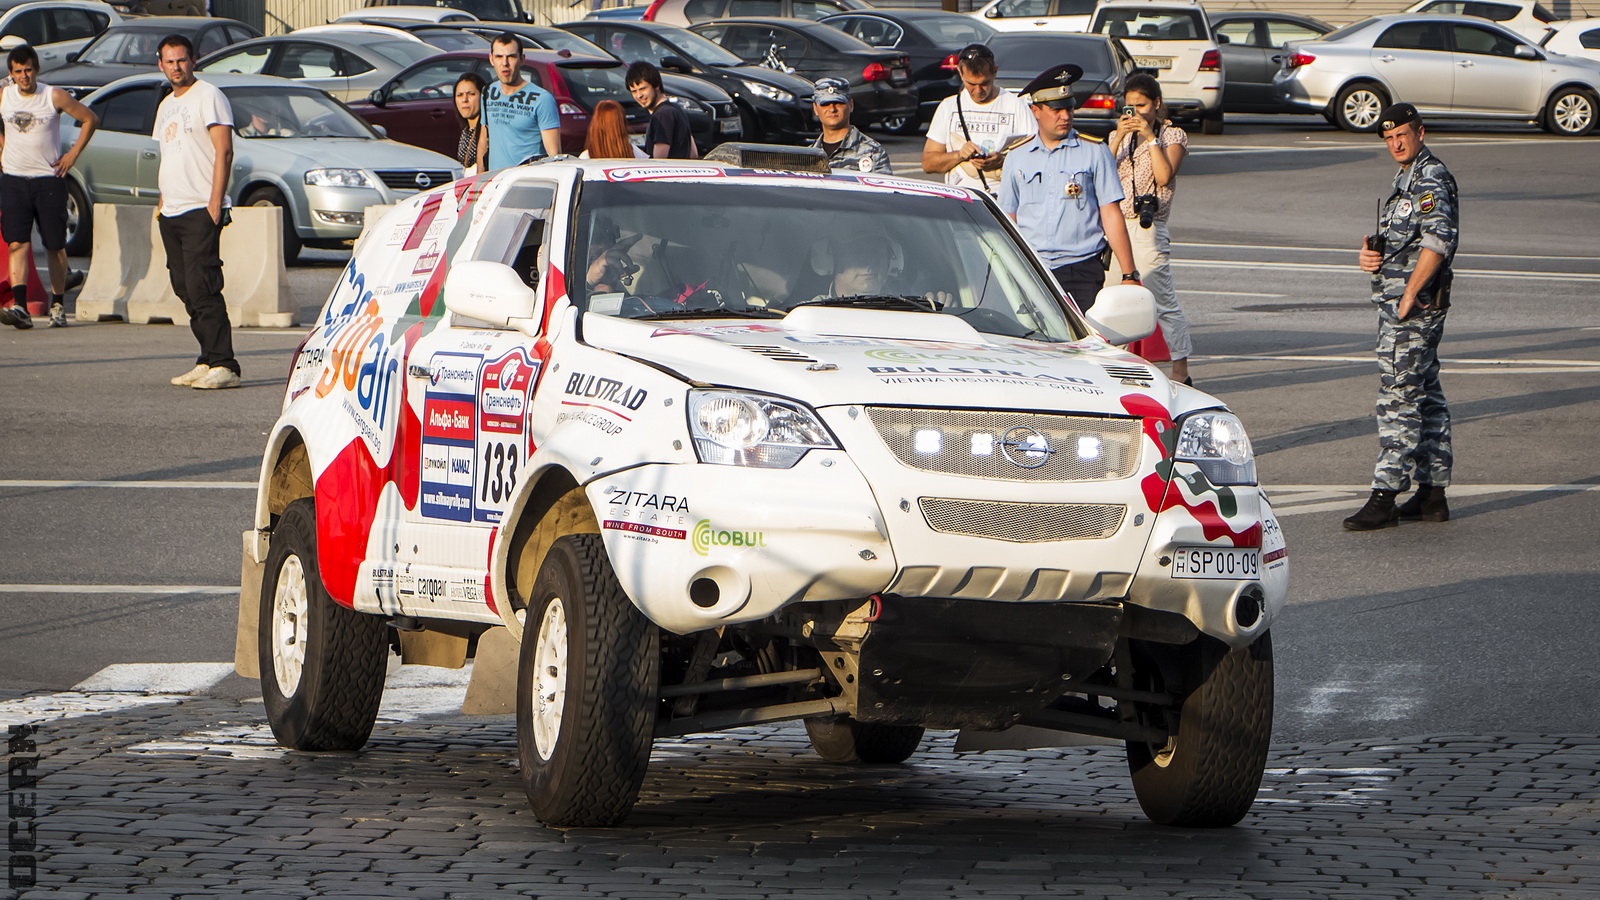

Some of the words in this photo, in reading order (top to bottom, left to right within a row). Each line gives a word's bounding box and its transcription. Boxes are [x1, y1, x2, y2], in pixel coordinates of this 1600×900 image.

[885, 350, 1049, 368] GLOBUL
[441, 366, 475, 383] Транснефть
[866, 366, 1094, 385] BULSTRAD
[565, 372, 648, 411] BULSTRAD
[880, 377, 945, 385] VIENNA
[949, 377, 1046, 388] INSURANCE
[1049, 383, 1104, 396] GROUP
[486, 392, 522, 411] Транснефть
[451, 458, 470, 474] KAMAZ
[482, 441, 518, 504] 133
[609, 490, 690, 513] ZITARA
[609, 507, 685, 525] ESTATE
[606, 521, 626, 530] WINE
[628, 524, 653, 534] FROM
[655, 527, 684, 539] SOUTH
[694, 524, 767, 550] GLOBUL
[417, 578, 447, 603] cargoair
